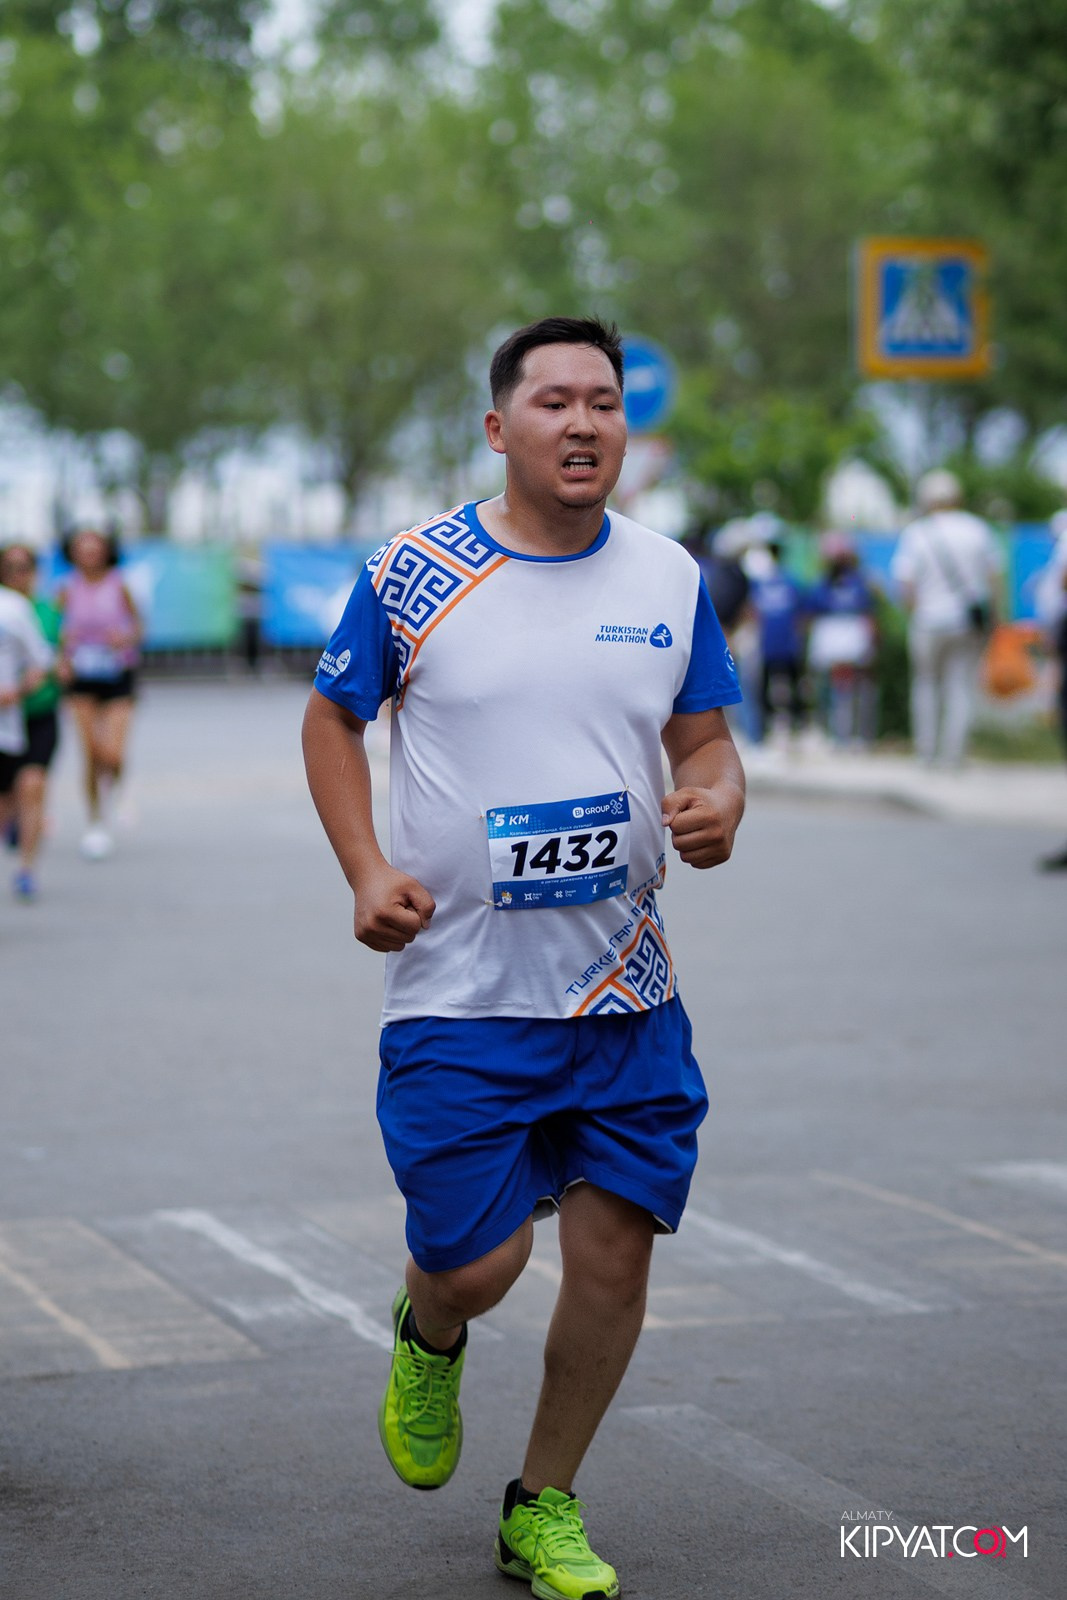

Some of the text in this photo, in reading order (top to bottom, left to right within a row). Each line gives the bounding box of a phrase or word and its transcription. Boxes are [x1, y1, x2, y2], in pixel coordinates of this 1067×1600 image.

[600, 625, 648, 635] TURKISTAN
[595, 634, 646, 644] MARATHON
[585, 804, 610, 815] GROUP
[494, 813, 529, 827] 5 KM
[511, 829, 618, 877] 1432
